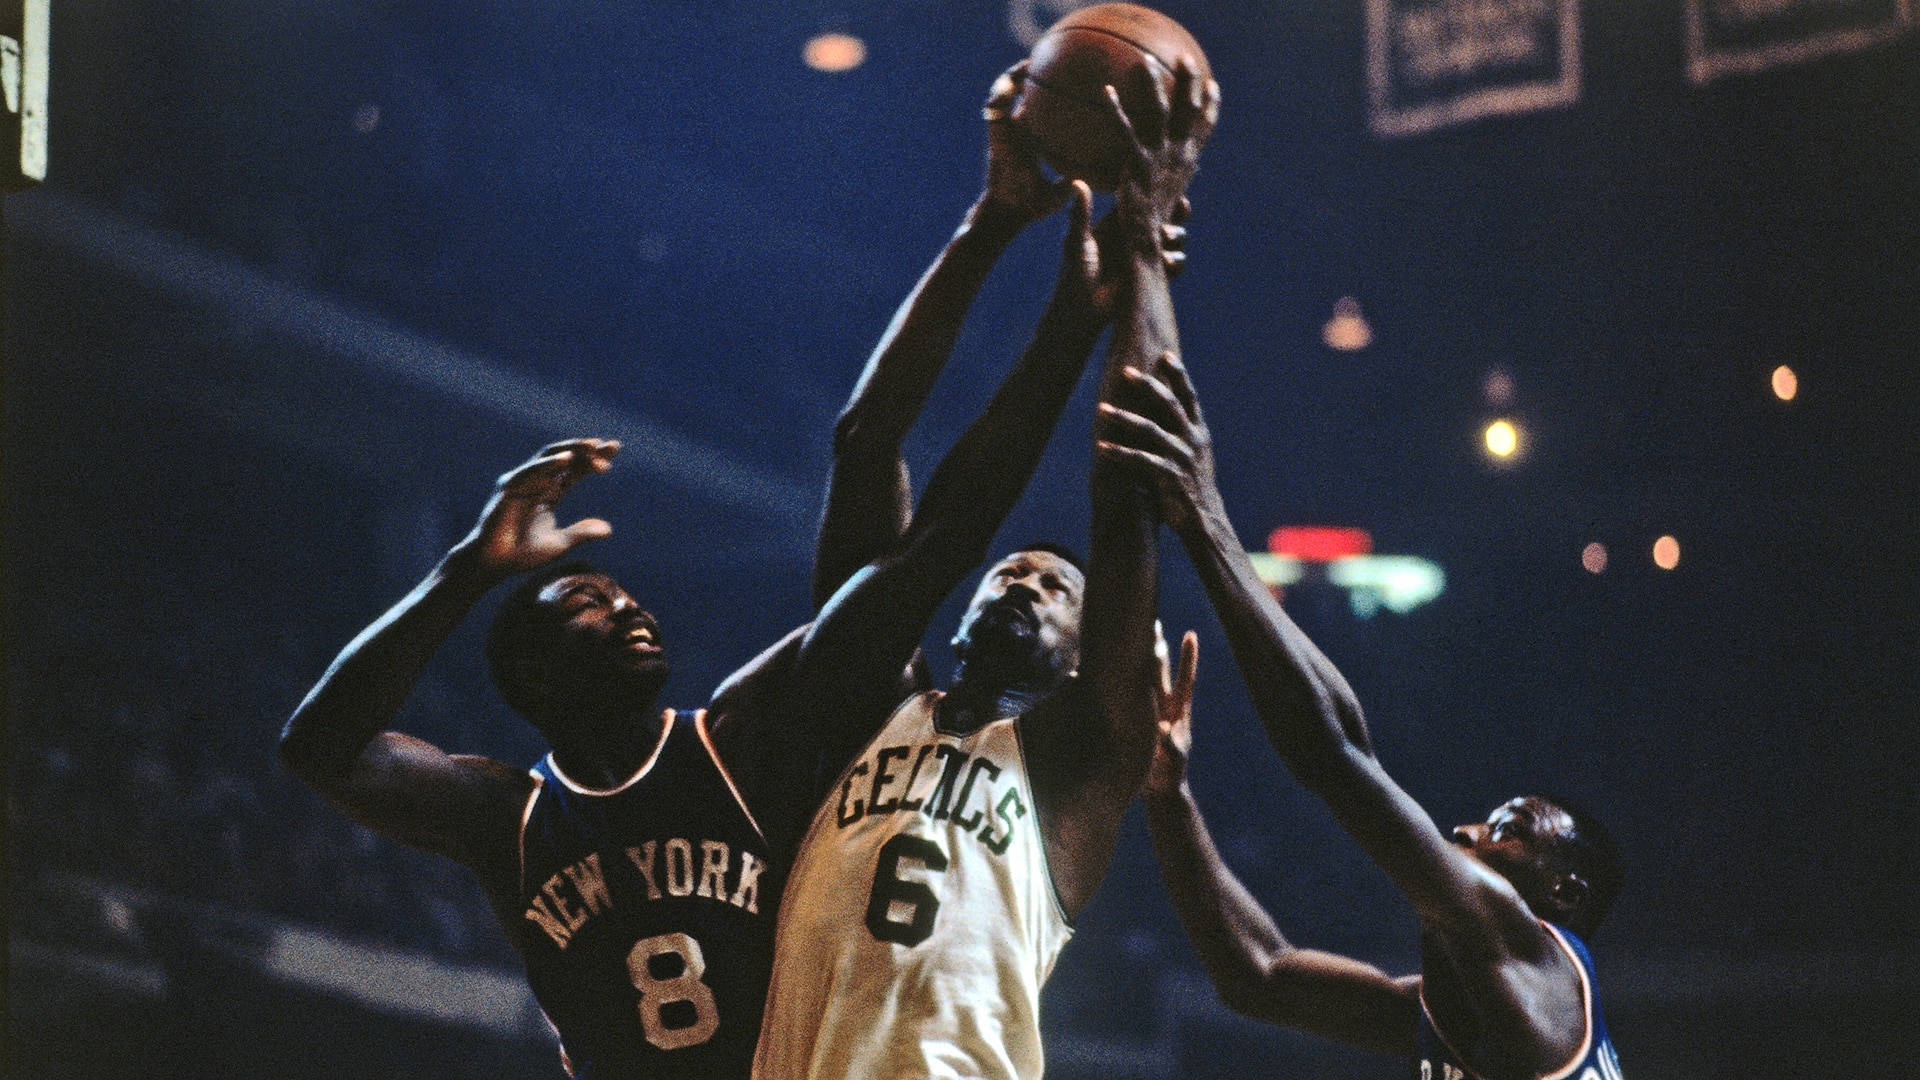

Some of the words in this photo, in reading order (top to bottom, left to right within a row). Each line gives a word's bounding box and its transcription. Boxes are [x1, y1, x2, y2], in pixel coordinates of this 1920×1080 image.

[837, 743, 1027, 856] CELTICS
[524, 852, 613, 950] NEW
[625, 837, 768, 915] YORK
[865, 832, 949, 948] 6
[625, 931, 720, 1050] 8
